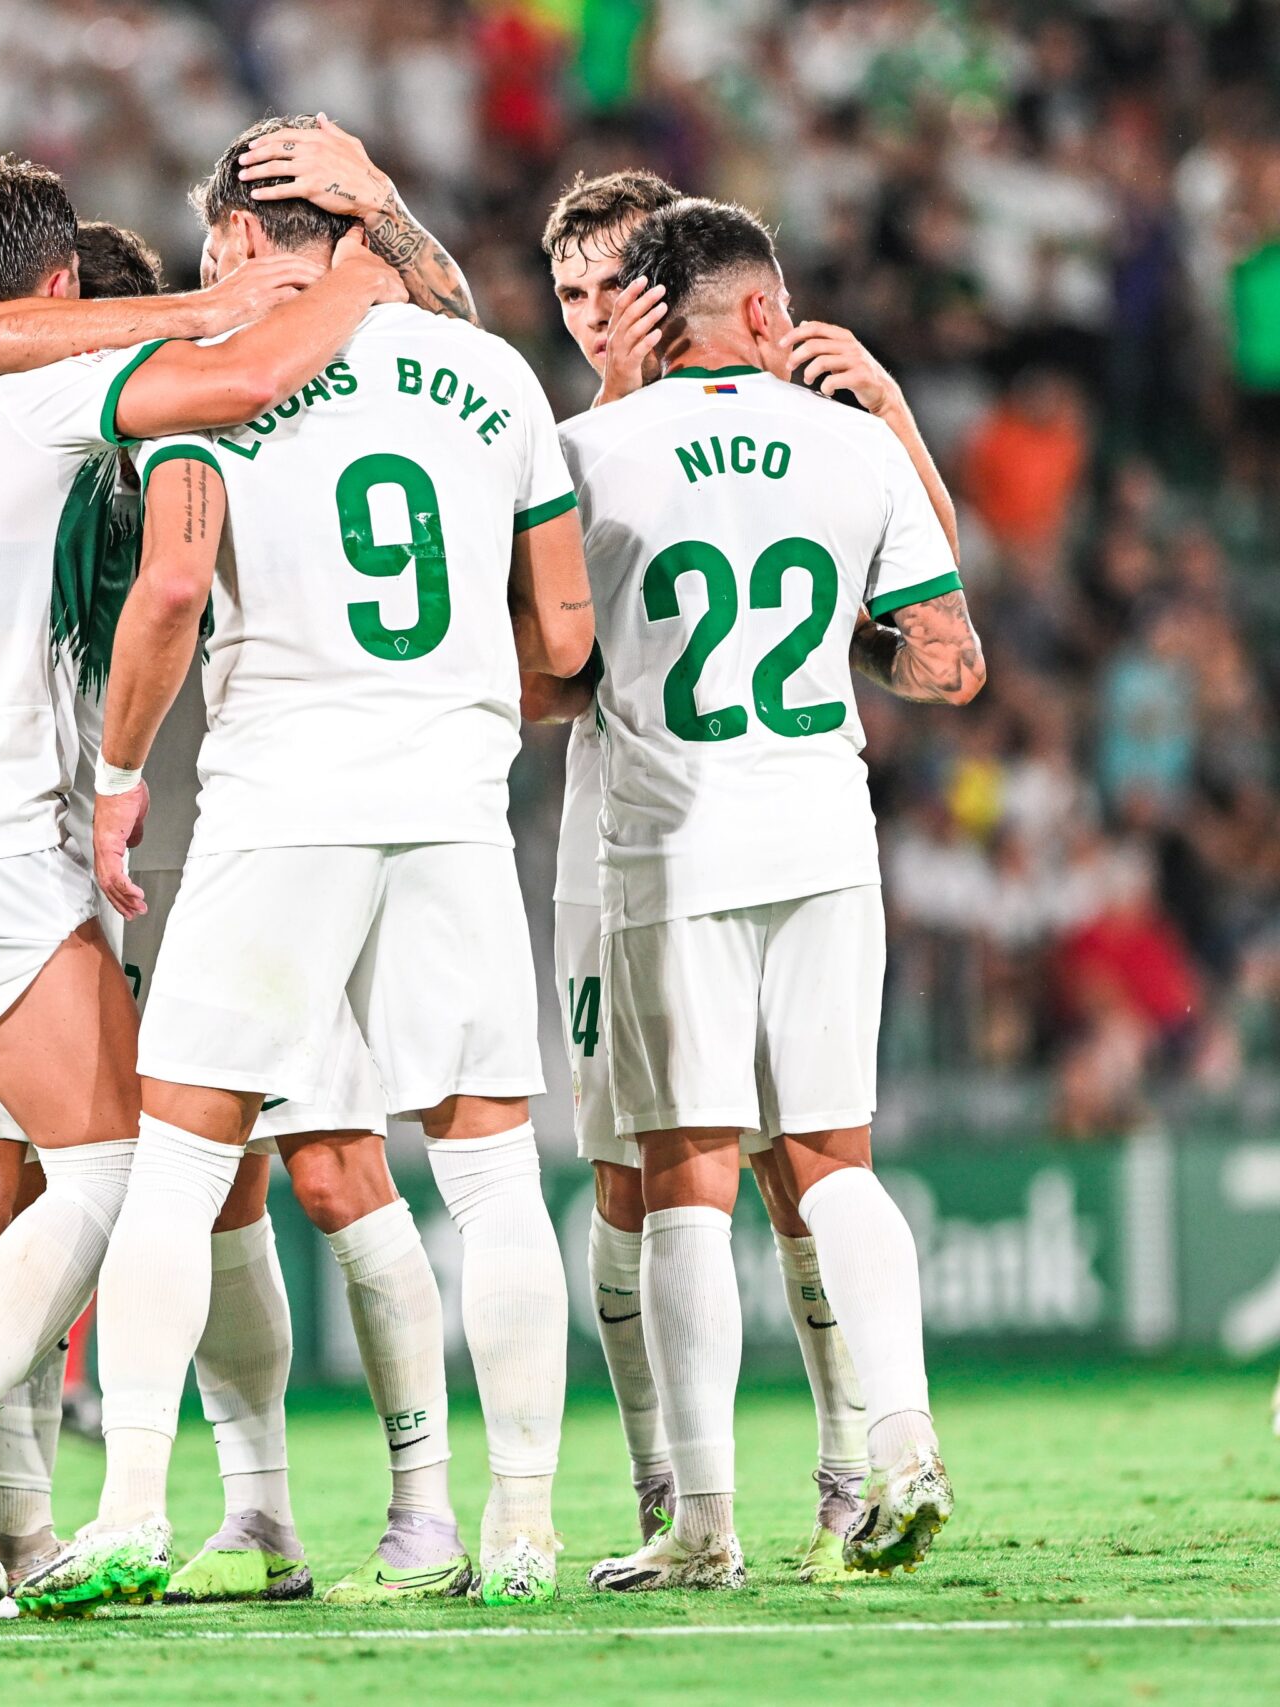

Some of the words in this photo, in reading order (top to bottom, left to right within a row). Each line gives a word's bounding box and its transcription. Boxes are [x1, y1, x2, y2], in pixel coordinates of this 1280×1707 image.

[397, 357, 511, 445] BOYÉ
[675, 435, 791, 483] NICO
[335, 453, 451, 661] 9
[644, 537, 847, 742] 22
[384, 1410, 427, 1432] ECF
